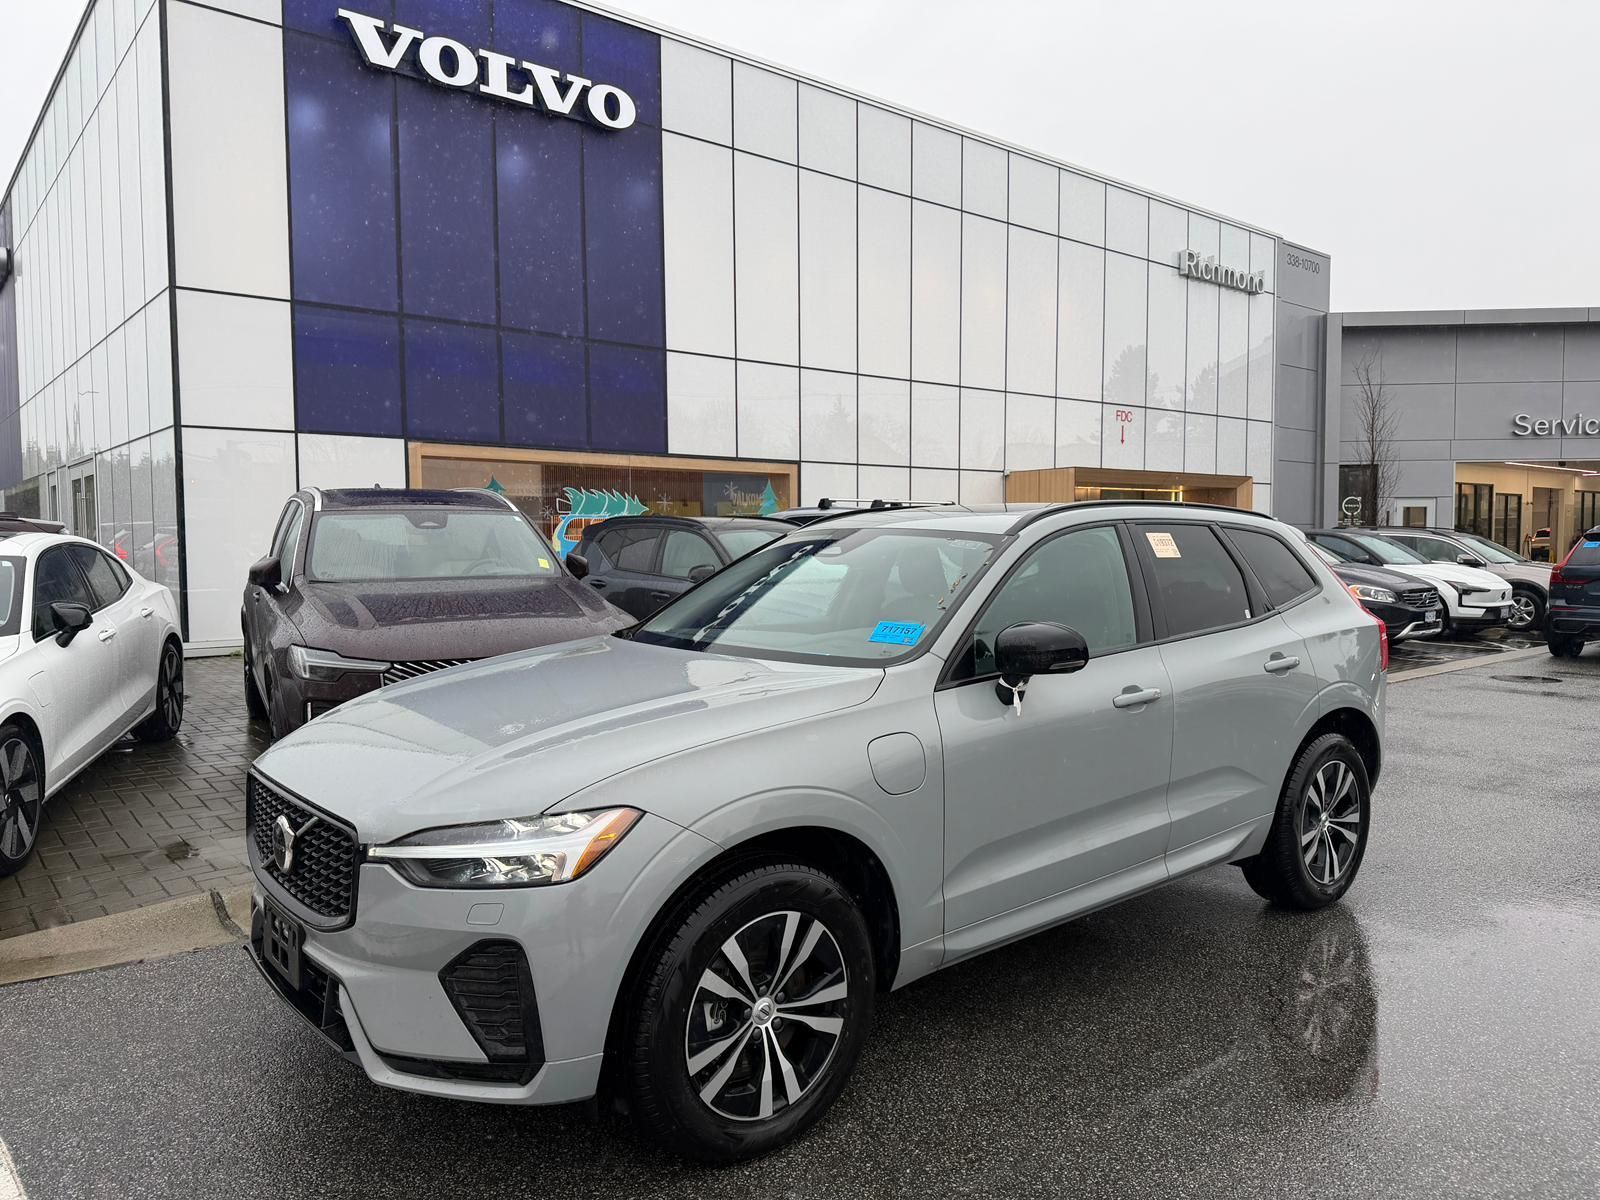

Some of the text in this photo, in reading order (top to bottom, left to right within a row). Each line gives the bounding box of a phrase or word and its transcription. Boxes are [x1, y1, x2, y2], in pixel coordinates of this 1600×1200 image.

[336, 8, 637, 130] VOLVO
[1181, 249, 1265, 294] Richmond
[1286, 253, 1320, 274] 338-10700
[1115, 409, 1133, 423] FDC
[881, 625, 917, 635] 717157
